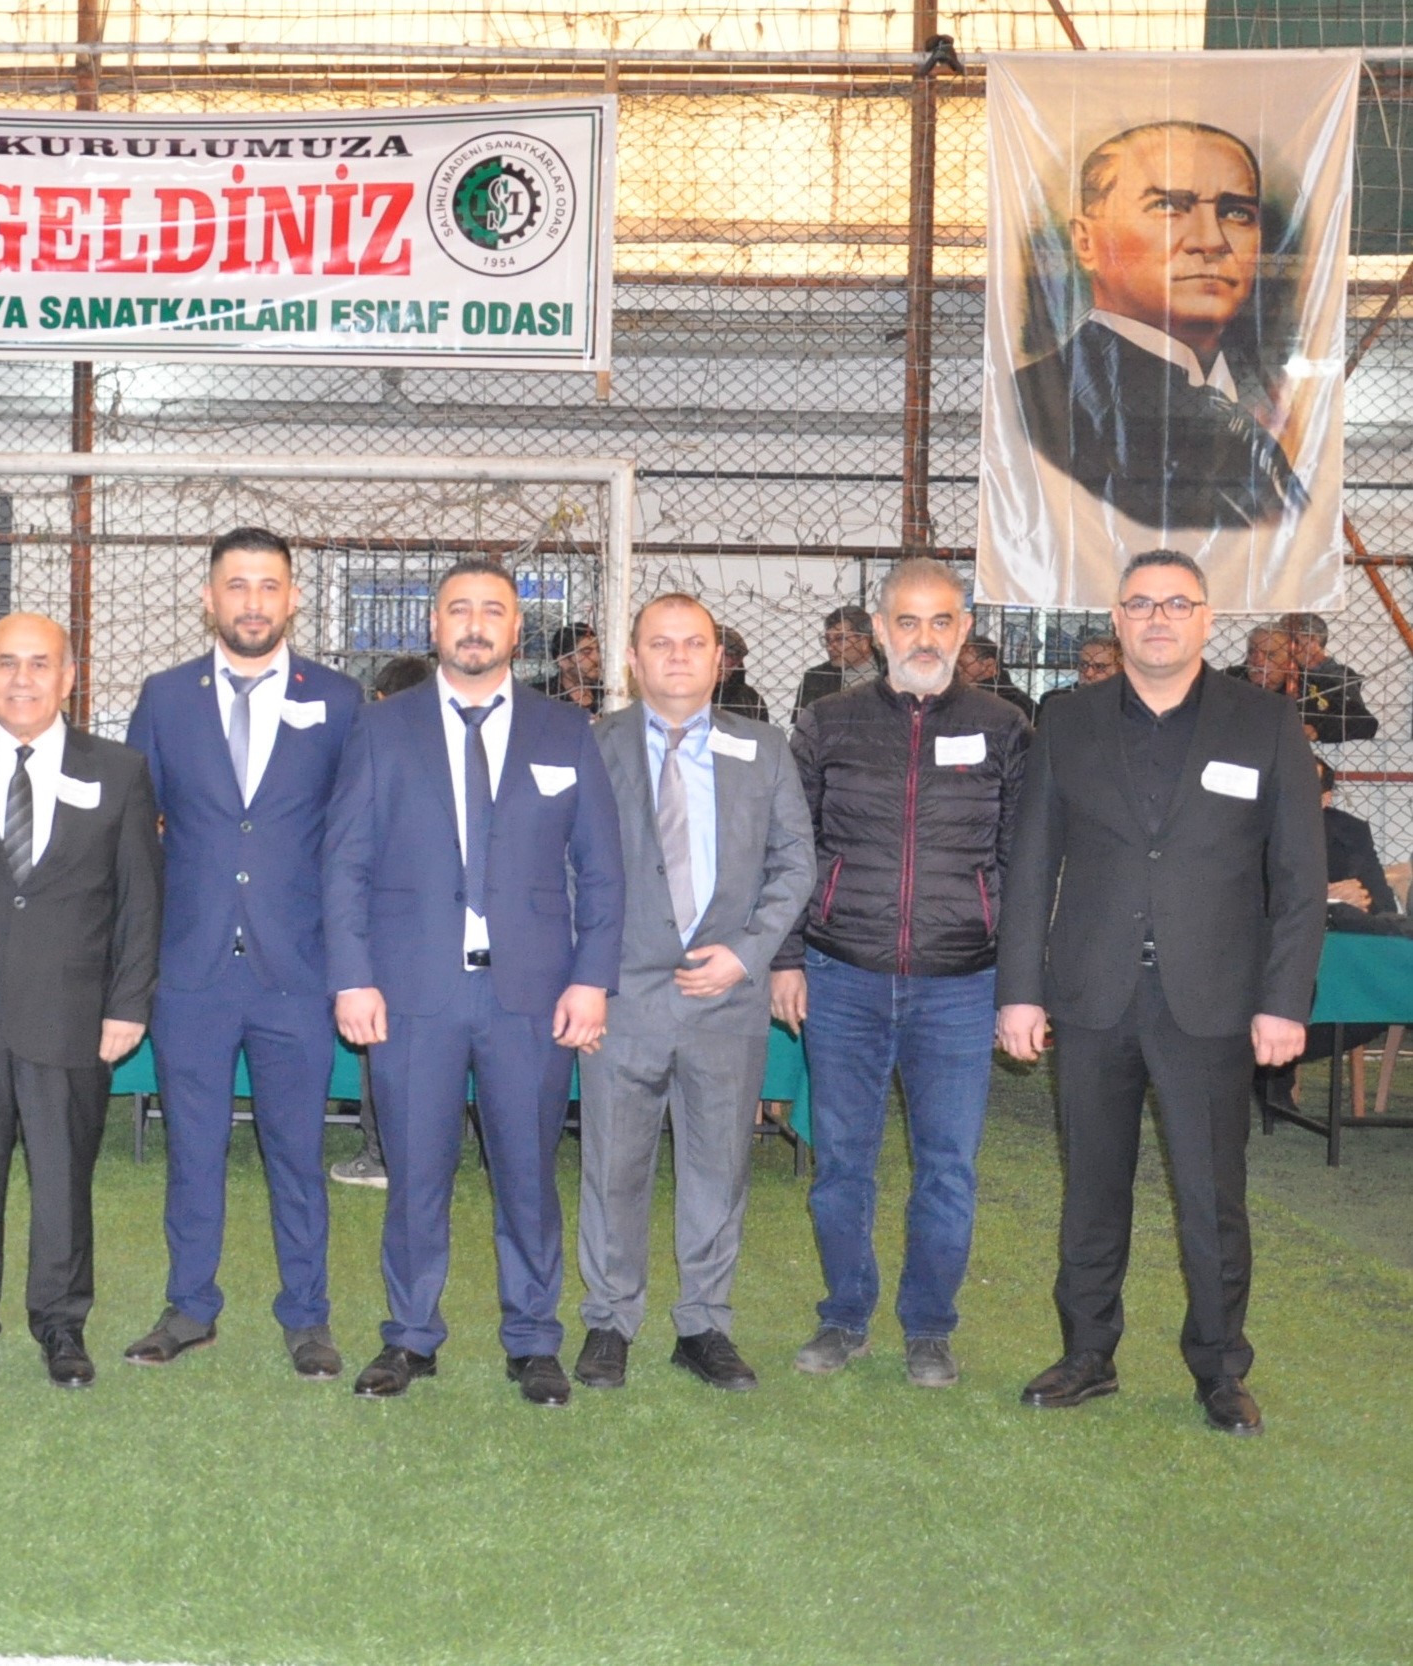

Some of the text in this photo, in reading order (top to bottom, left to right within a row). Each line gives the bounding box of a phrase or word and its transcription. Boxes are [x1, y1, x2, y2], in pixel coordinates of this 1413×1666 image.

[442, 144, 484, 184] MADENİ
[434, 186, 454, 238] SALİHLİ
[546, 197, 567, 239] ODASI
[483, 256, 516, 268] 1954
[39, 296, 317, 333] SANATKARLARI
[330, 299, 450, 335] ESNAF
[461, 300, 574, 336] ODASI
